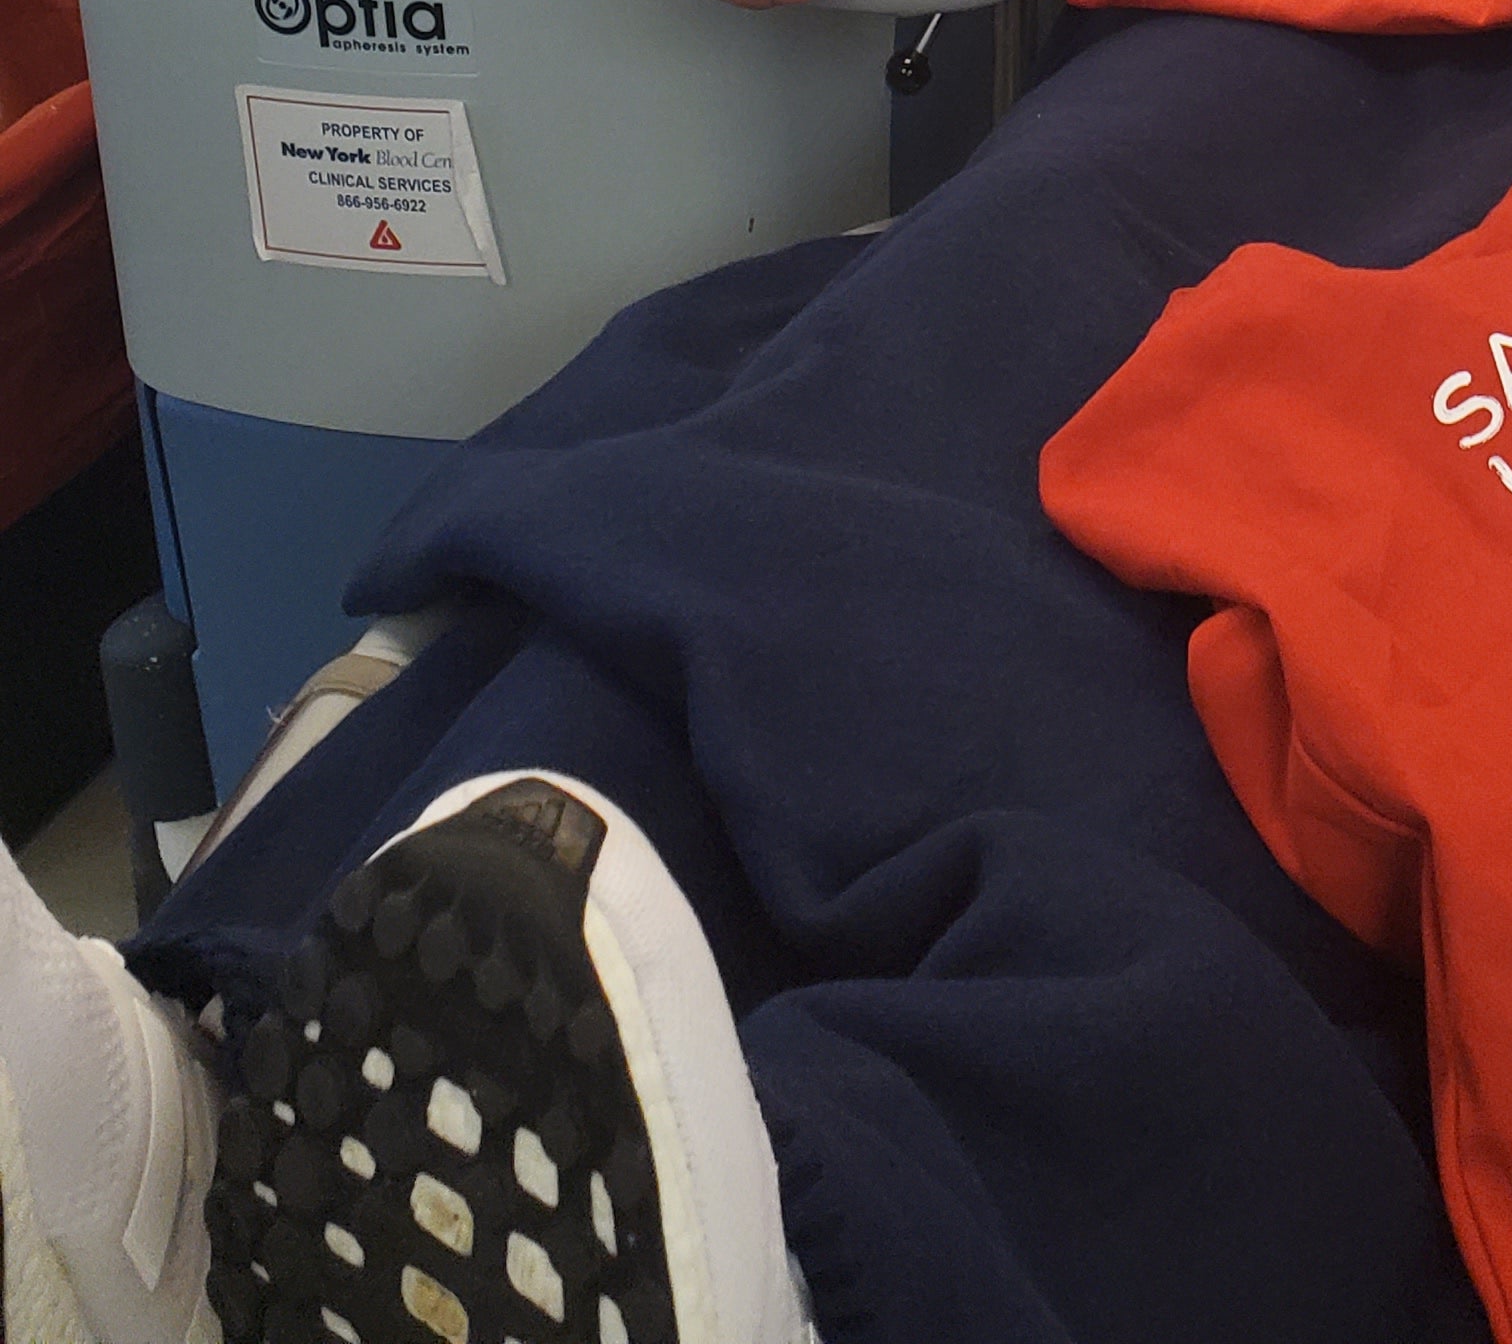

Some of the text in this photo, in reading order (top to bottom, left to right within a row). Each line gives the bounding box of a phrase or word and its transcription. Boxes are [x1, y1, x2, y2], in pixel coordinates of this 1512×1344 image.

[332, 39, 471, 56] apheresis system
[321, 122, 425, 142] PROPERTY OF
[281, 142, 455, 170] New York Blood Cen
[308, 171, 452, 194] CLINICAL SERVICES
[336, 194, 427, 213] 866-956-6922
